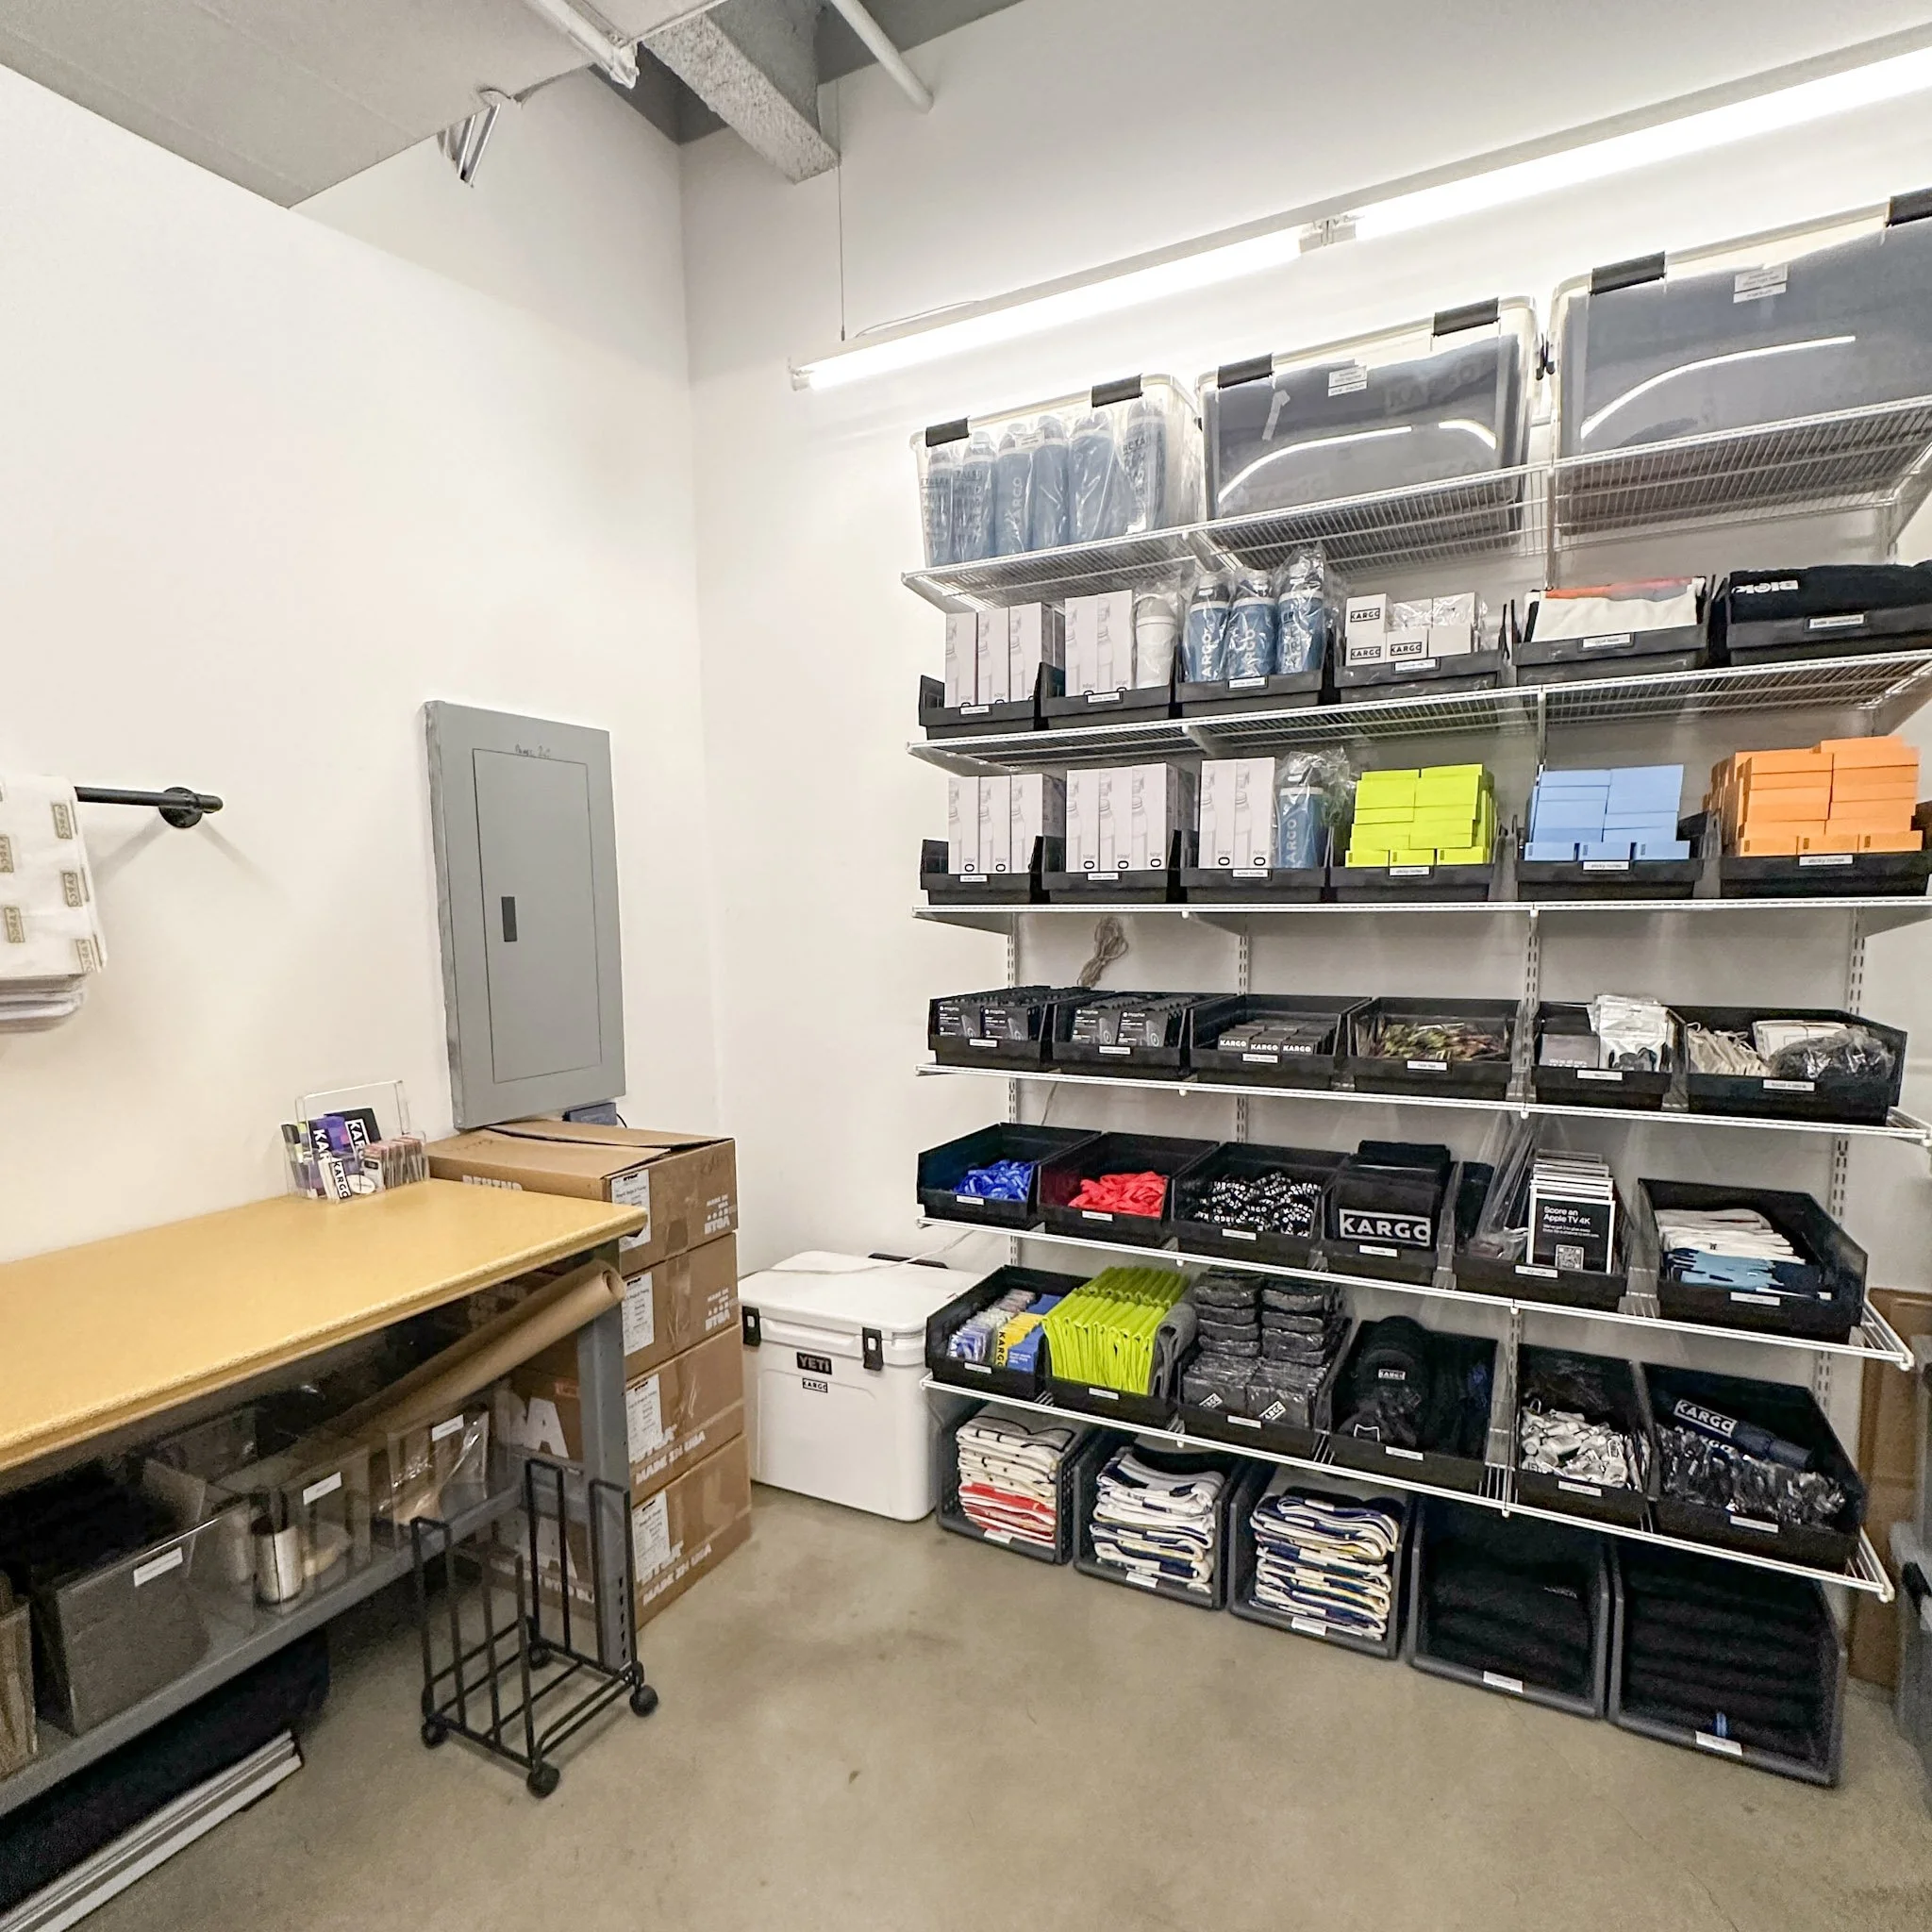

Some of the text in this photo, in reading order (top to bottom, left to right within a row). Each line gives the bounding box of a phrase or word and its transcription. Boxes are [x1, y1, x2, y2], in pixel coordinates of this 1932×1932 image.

[1351, 609, 1379, 620] KARGO
[1201, 633, 1212, 677] ARGO
[1352, 649, 1380, 658] KARGO
[1391, 643, 1421, 654] KARGO
[1287, 819, 1297, 863] ARGO
[333, 1161, 349, 1196] KARGO
[1543, 1206, 1567, 1215] Score
[1543, 1214, 1567, 1224] Apple
[1579, 1217, 1591, 1225] 4K
[1343, 1217, 1428, 1241] KARGO
[799, 1356, 830, 1372] YETI
[803, 1379, 827, 1390] KARGO
[1677, 1402, 1735, 1433] KARGO
